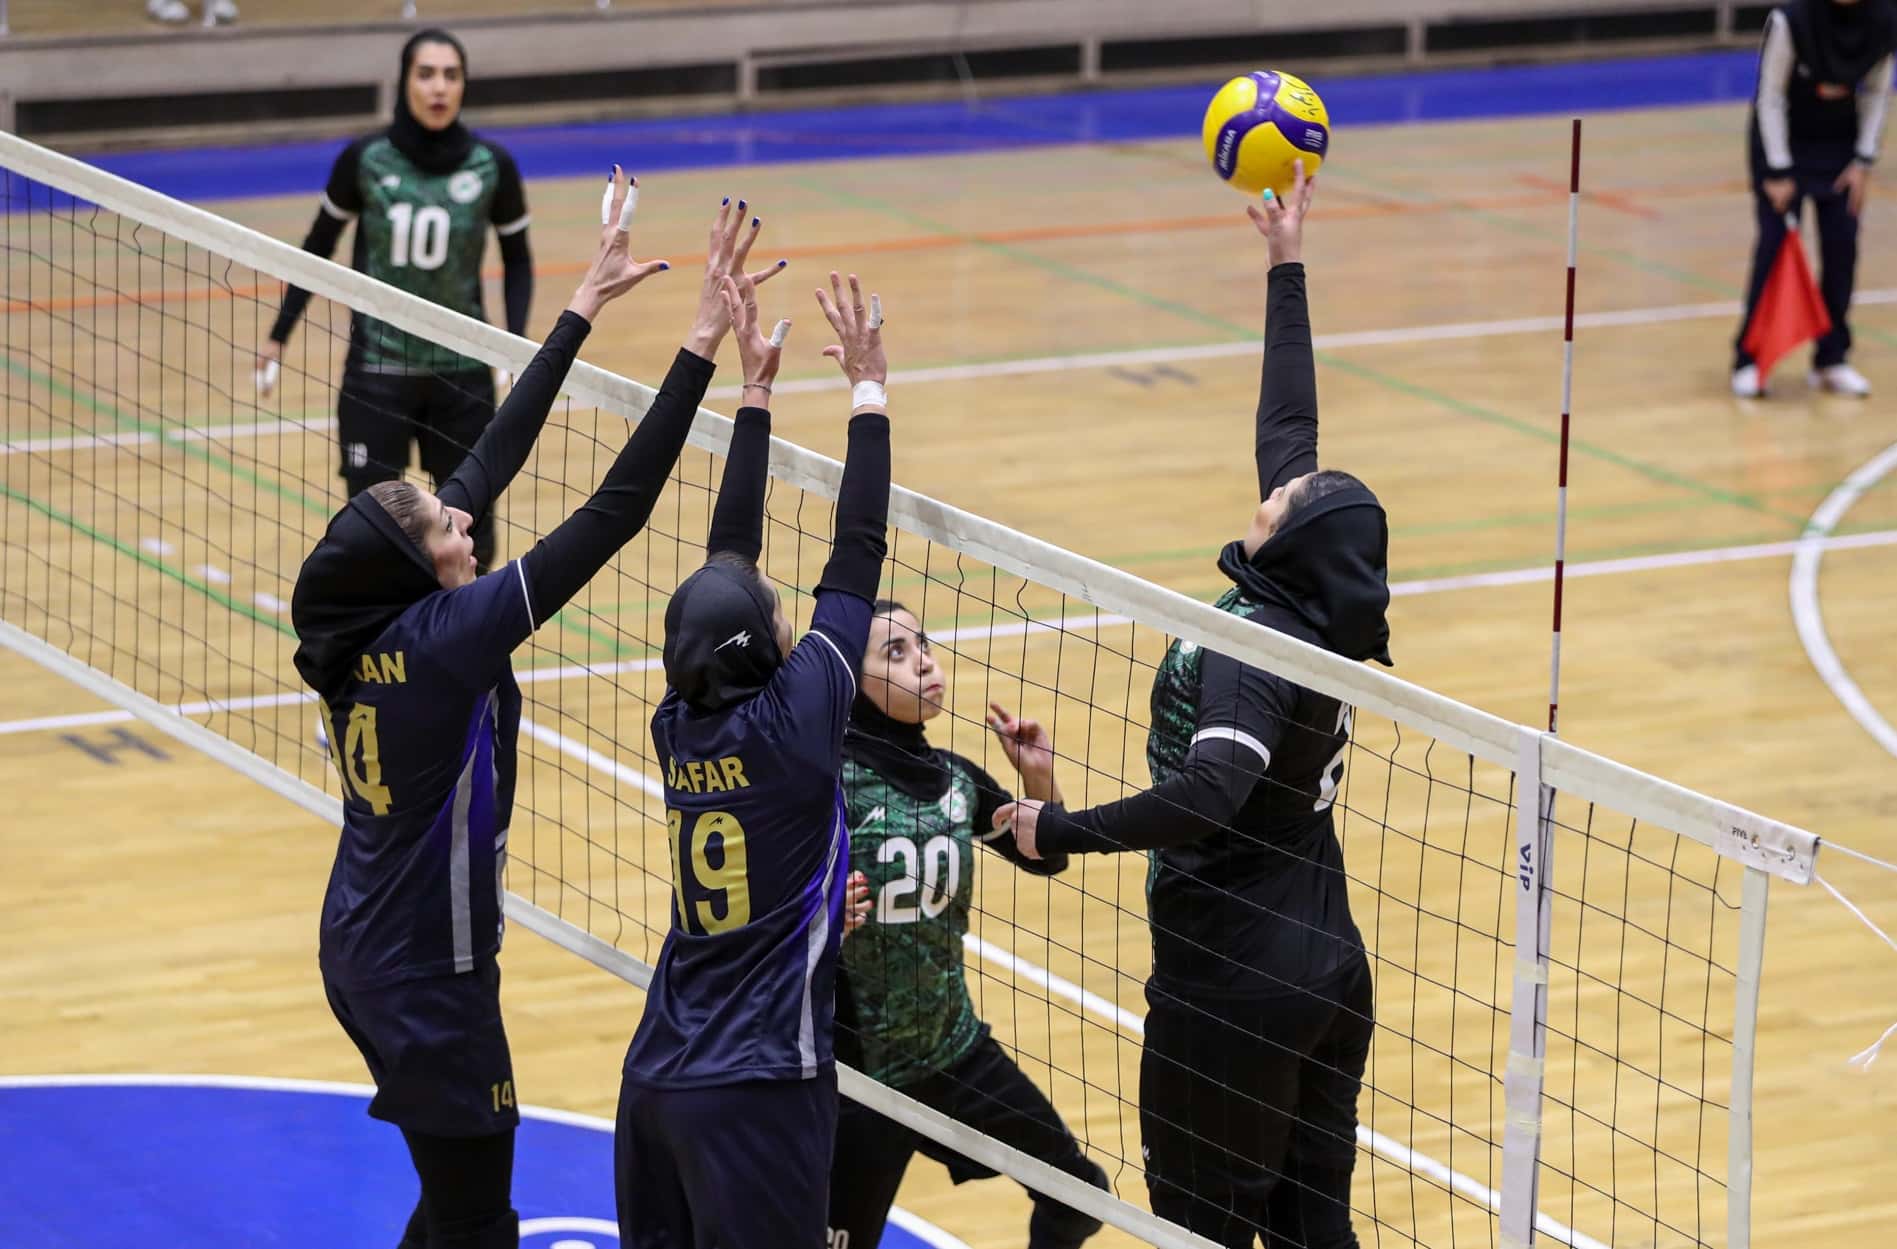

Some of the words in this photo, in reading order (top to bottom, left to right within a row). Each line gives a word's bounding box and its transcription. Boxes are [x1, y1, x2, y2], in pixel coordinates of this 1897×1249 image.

[386, 202, 451, 270] 10
[354, 650, 407, 684] AN
[667, 755, 750, 794] SAFAR
[666, 809, 750, 936] 19
[876, 835, 960, 924] 20
[491, 1080, 513, 1112] 14
